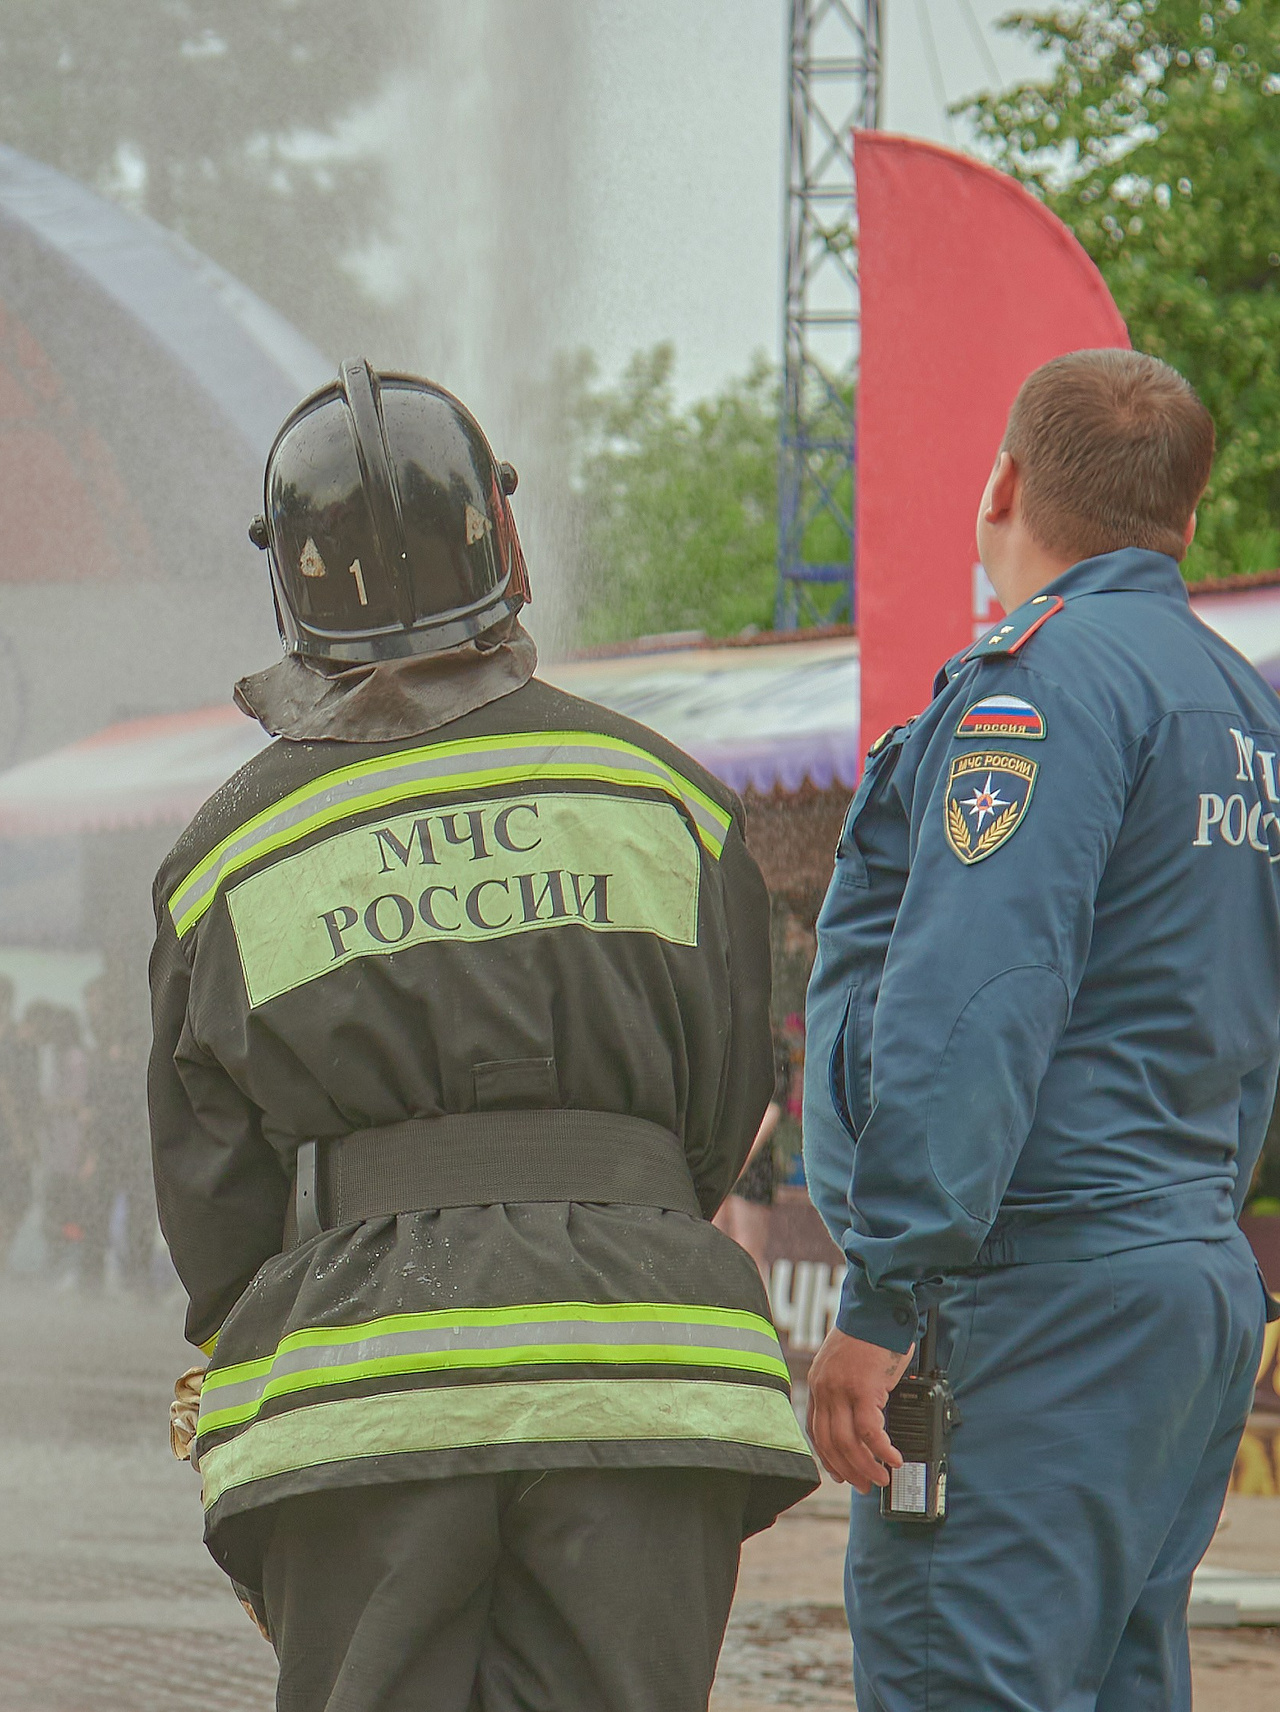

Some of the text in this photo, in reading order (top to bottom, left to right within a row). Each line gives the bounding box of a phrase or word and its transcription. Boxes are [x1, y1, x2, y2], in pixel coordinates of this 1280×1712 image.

[349, 558, 368, 606] 1
[974, 723, 1028, 734] РОССИЯ
[957, 755, 1032, 776] МЧС РОССИИ
[369, 803, 543, 874] МЧС
[318, 869, 614, 962] РОССИИ
